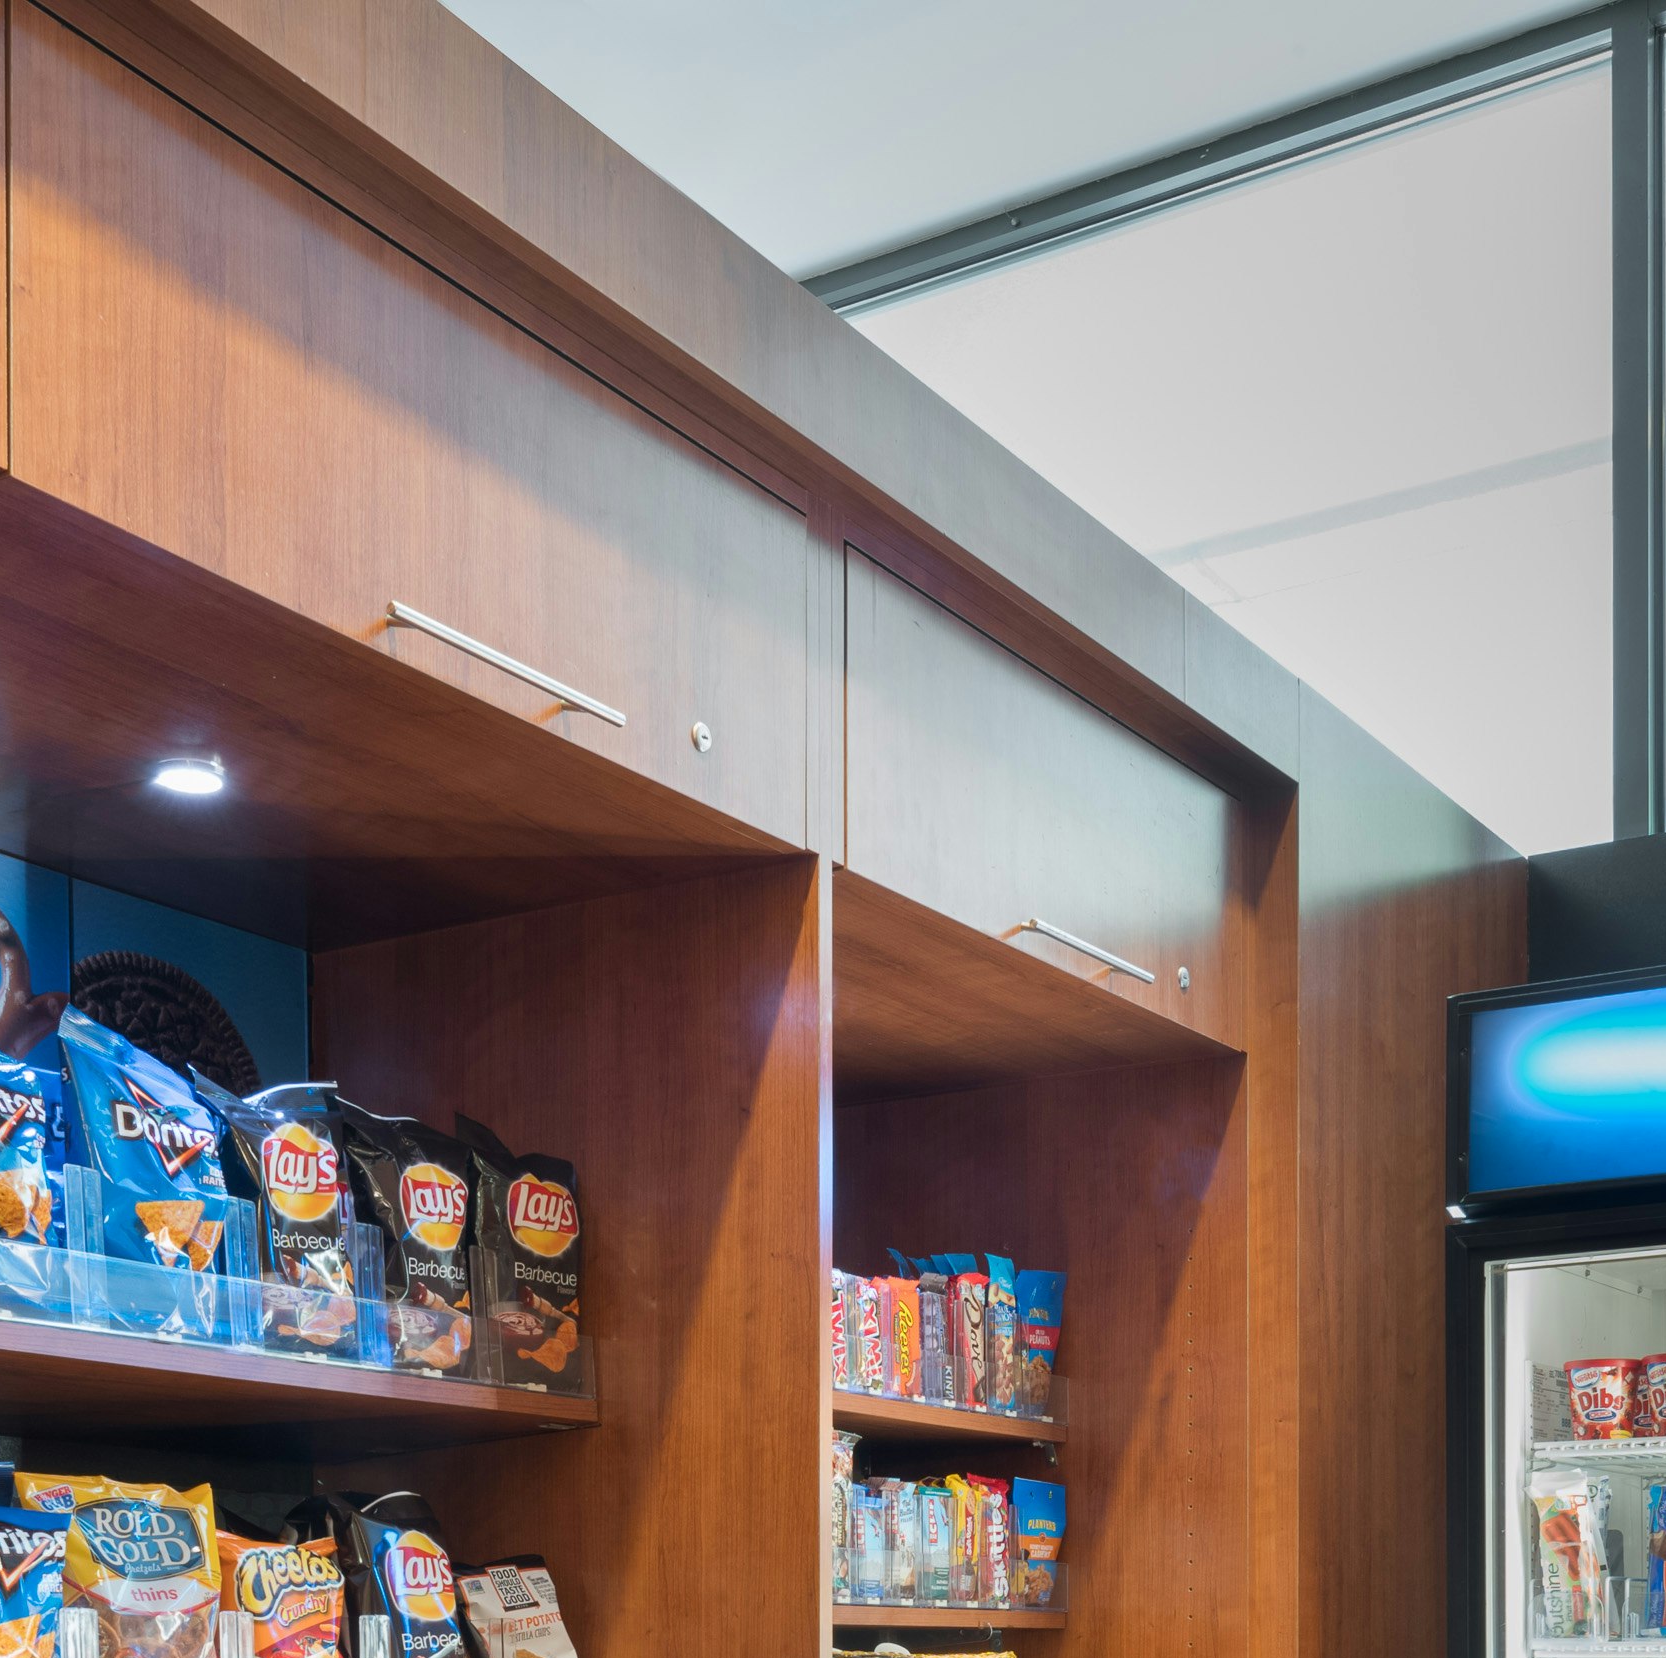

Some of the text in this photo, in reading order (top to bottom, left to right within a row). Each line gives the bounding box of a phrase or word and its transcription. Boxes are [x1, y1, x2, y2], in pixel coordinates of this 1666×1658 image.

[268, 1141, 338, 1194] Lay's
[410, 1183, 468, 1223] Lay's
[516, 1183, 573, 1232] Lay's
[272, 1228, 346, 1251] Barbecue
[408, 1257, 466, 1281] Barbecue
[514, 1262, 578, 1287] Barbecue
[831, 1291, 849, 1384] TWIX
[898, 1300, 915, 1377] Reese's
[1029, 1334, 1051, 1346] PEANUTS
[1576, 1386, 1626, 1412] Dibs
[93, 1507, 177, 1540] ROLD
[1027, 1519, 1057, 1532] PLANTERS
[94, 1536, 192, 1568] GOLD
[124, 1561, 162, 1575] Pretzels
[238, 1549, 340, 1612] Cheetos
[395, 1548, 453, 1597] Lay's
[490, 1568, 517, 1581] FOOD
[131, 1586, 179, 1602] thins
[495, 1578, 521, 1588] SHOULD
[499, 1586, 526, 1597] TASTE
[279, 1592, 329, 1625] Crunchy
[504, 1593, 531, 1606] GOOD
[1547, 1561, 1565, 1638] outshine
[534, 1626, 552, 1639] CHIPS
